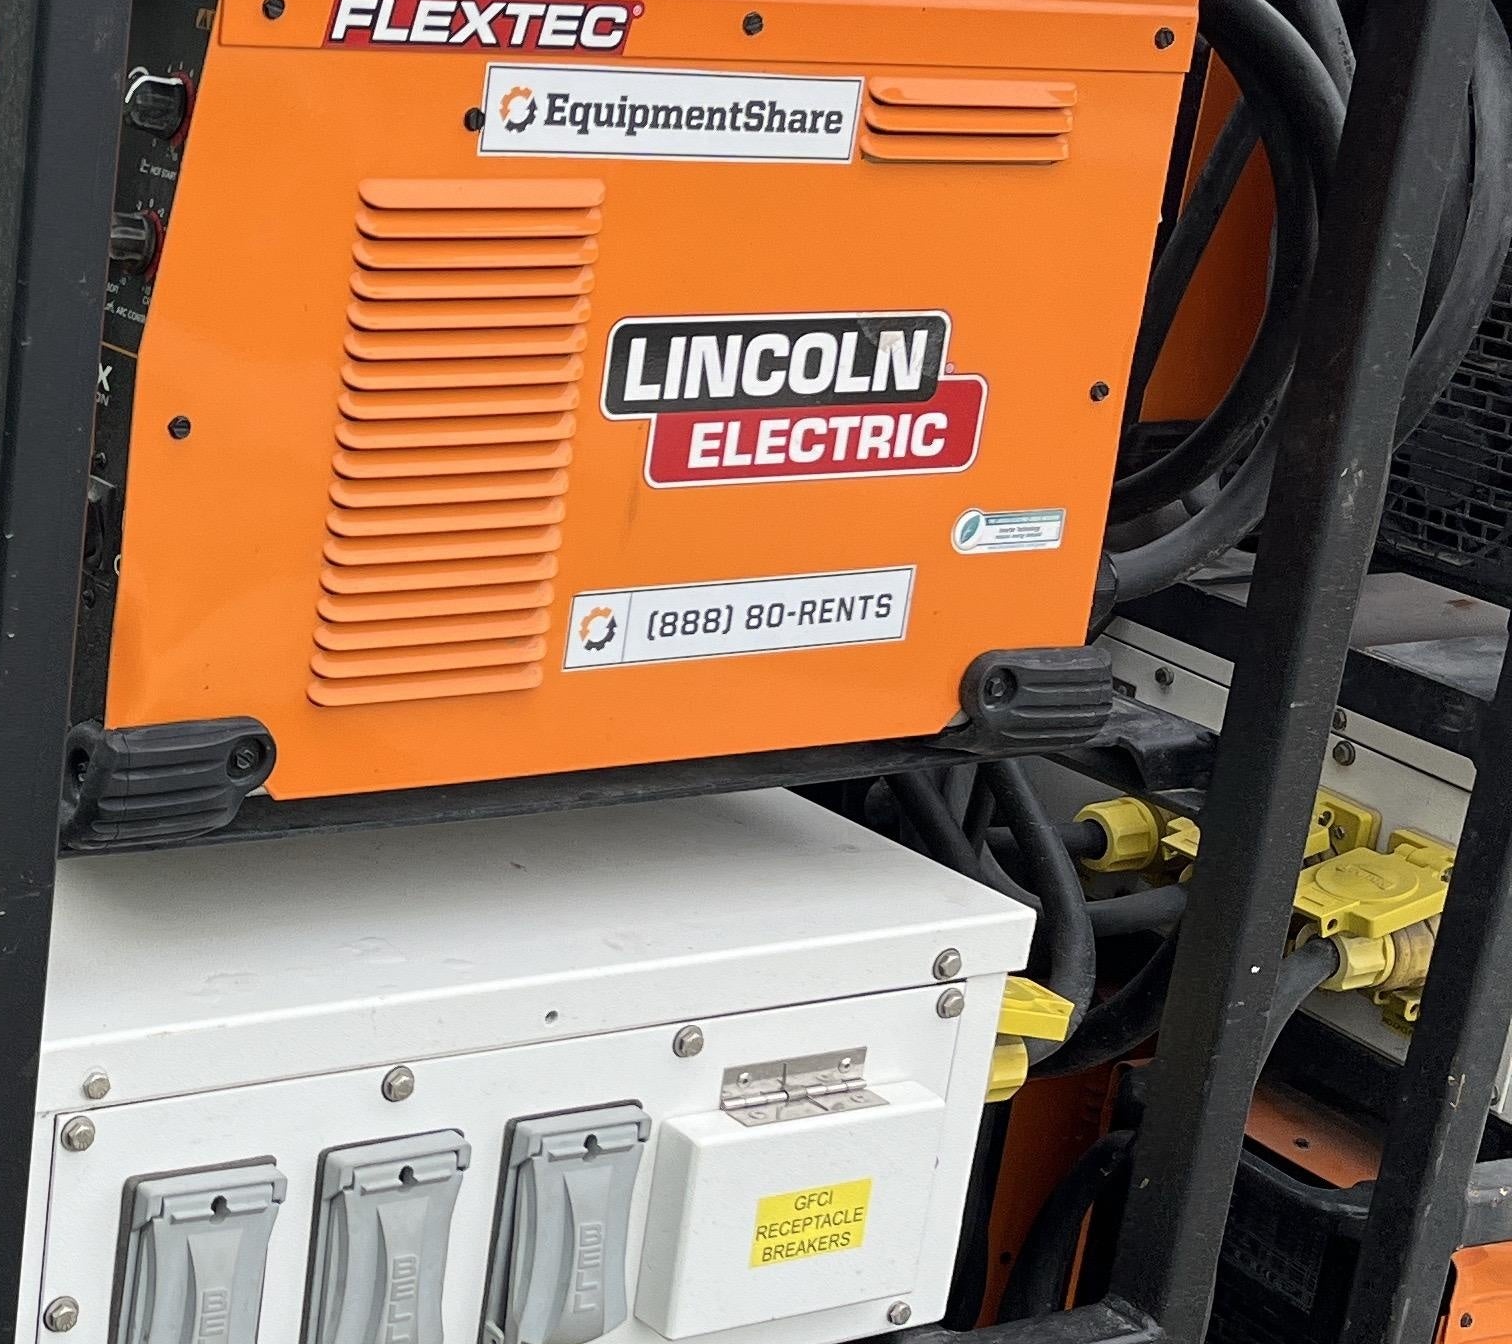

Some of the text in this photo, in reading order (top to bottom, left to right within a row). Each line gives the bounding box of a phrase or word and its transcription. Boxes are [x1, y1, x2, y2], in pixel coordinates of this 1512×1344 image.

[544, 92, 844, 137] EquipmentShare
[623, 329, 928, 402] LINCOLN
[687, 412, 948, 469] ELECTRIC
[646, 593, 893, 641] (888) 80-RENTS
[794, 1189, 834, 1211] GFCI
[755, 1207, 864, 1241] RECEPTACLE
[762, 1231, 851, 1262] BREAKERS
[572, 1223, 603, 1313] BELL
